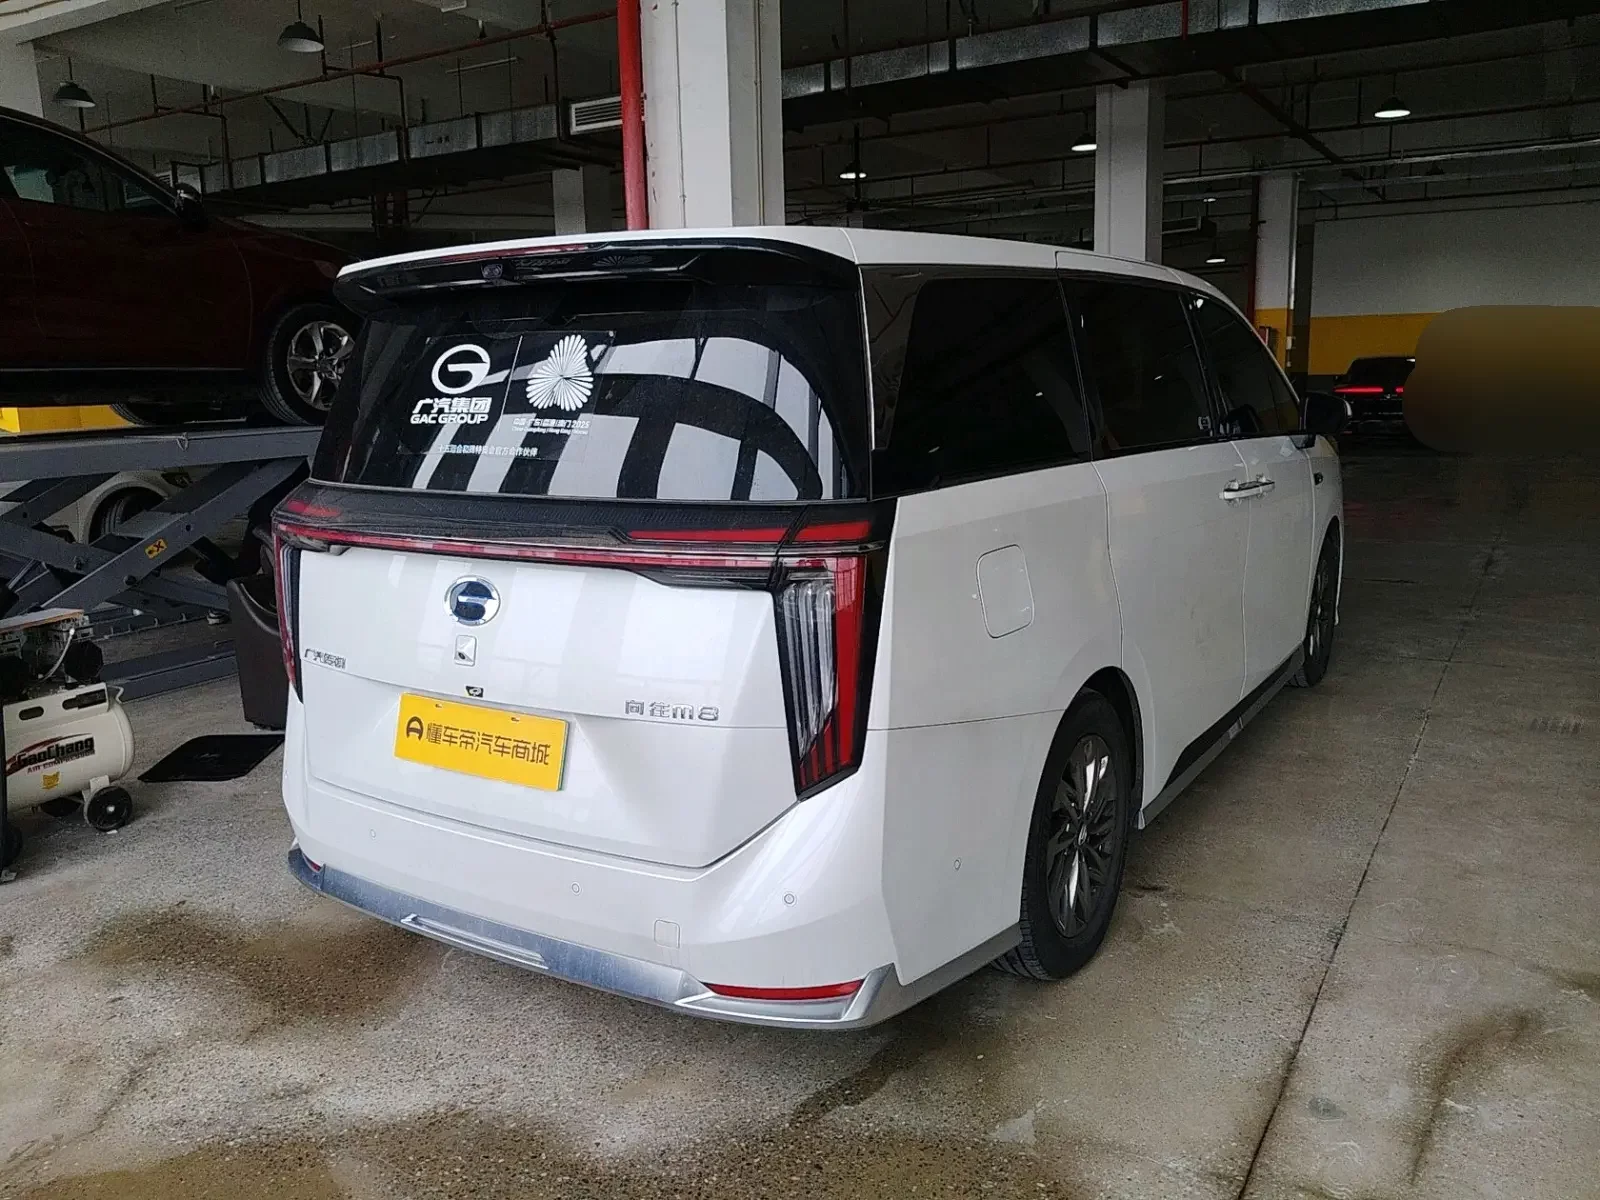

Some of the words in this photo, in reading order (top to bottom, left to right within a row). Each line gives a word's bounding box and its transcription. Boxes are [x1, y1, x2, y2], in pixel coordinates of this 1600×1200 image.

[412, 397, 492, 414] 广汽集团
[410, 413, 438, 424] GAC
[438, 413, 489, 424] GROUP
[572, 420, 590, 429] 2025
[427, 722, 551, 766] 懂车帝汽车商城
